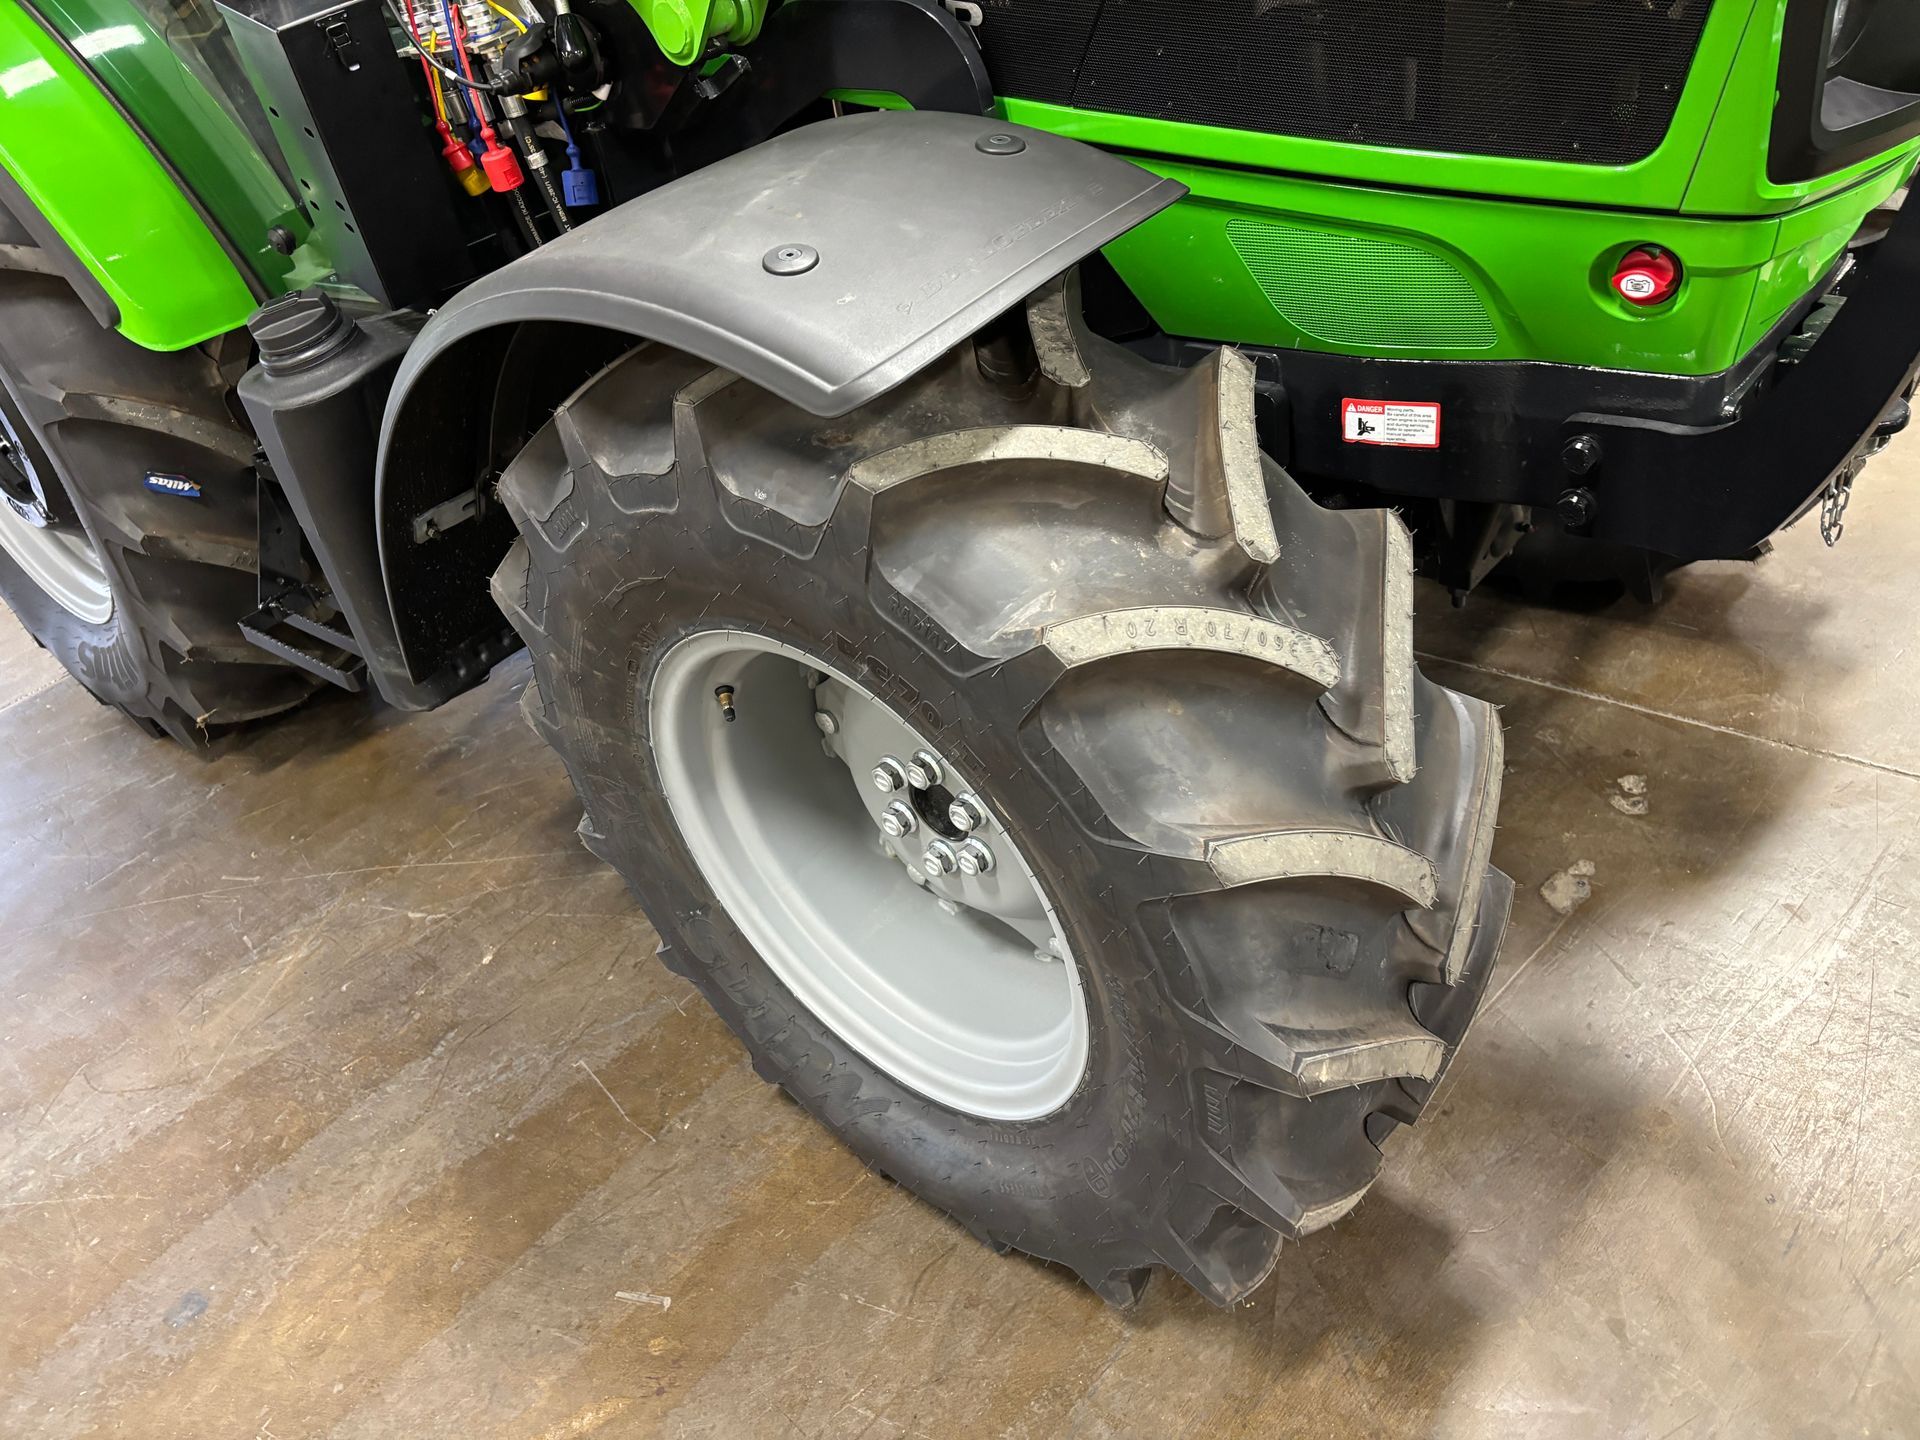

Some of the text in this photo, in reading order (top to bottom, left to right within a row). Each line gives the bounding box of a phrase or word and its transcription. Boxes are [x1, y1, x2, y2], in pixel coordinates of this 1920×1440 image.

[1357, 405, 1382, 414] DANGER
[148, 476, 193, 491] Mitas
[1125, 619, 1158, 639] 20
[1174, 618, 1188, 635] R
